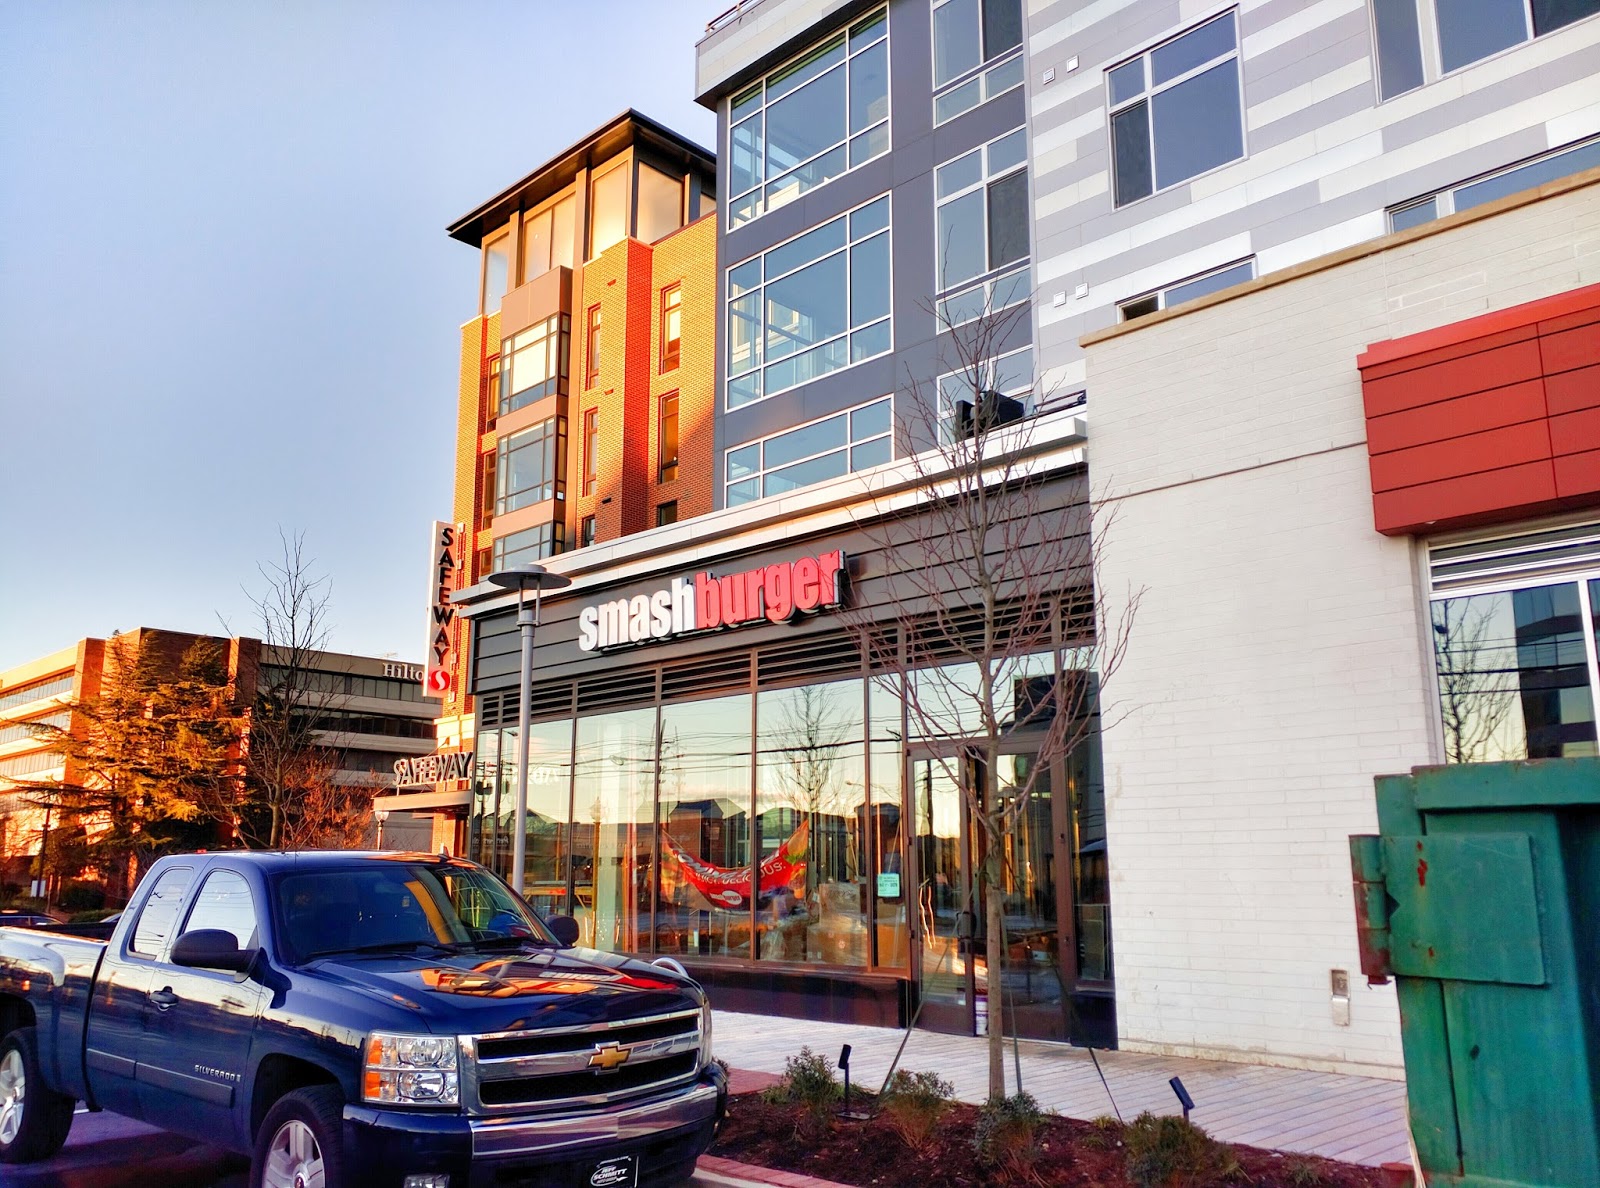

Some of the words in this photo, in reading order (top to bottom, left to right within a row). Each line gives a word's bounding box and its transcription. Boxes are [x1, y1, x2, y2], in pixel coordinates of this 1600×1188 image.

[433, 527, 455, 666] SAFEWAY
[579, 550, 845, 652] smashburger
[383, 662, 424, 681] Hilto
[393, 752, 474, 786] SAFEWAY
[194, 1064, 235, 1081] SILVERADO
[593, 1168, 628, 1180] SCHMITT
